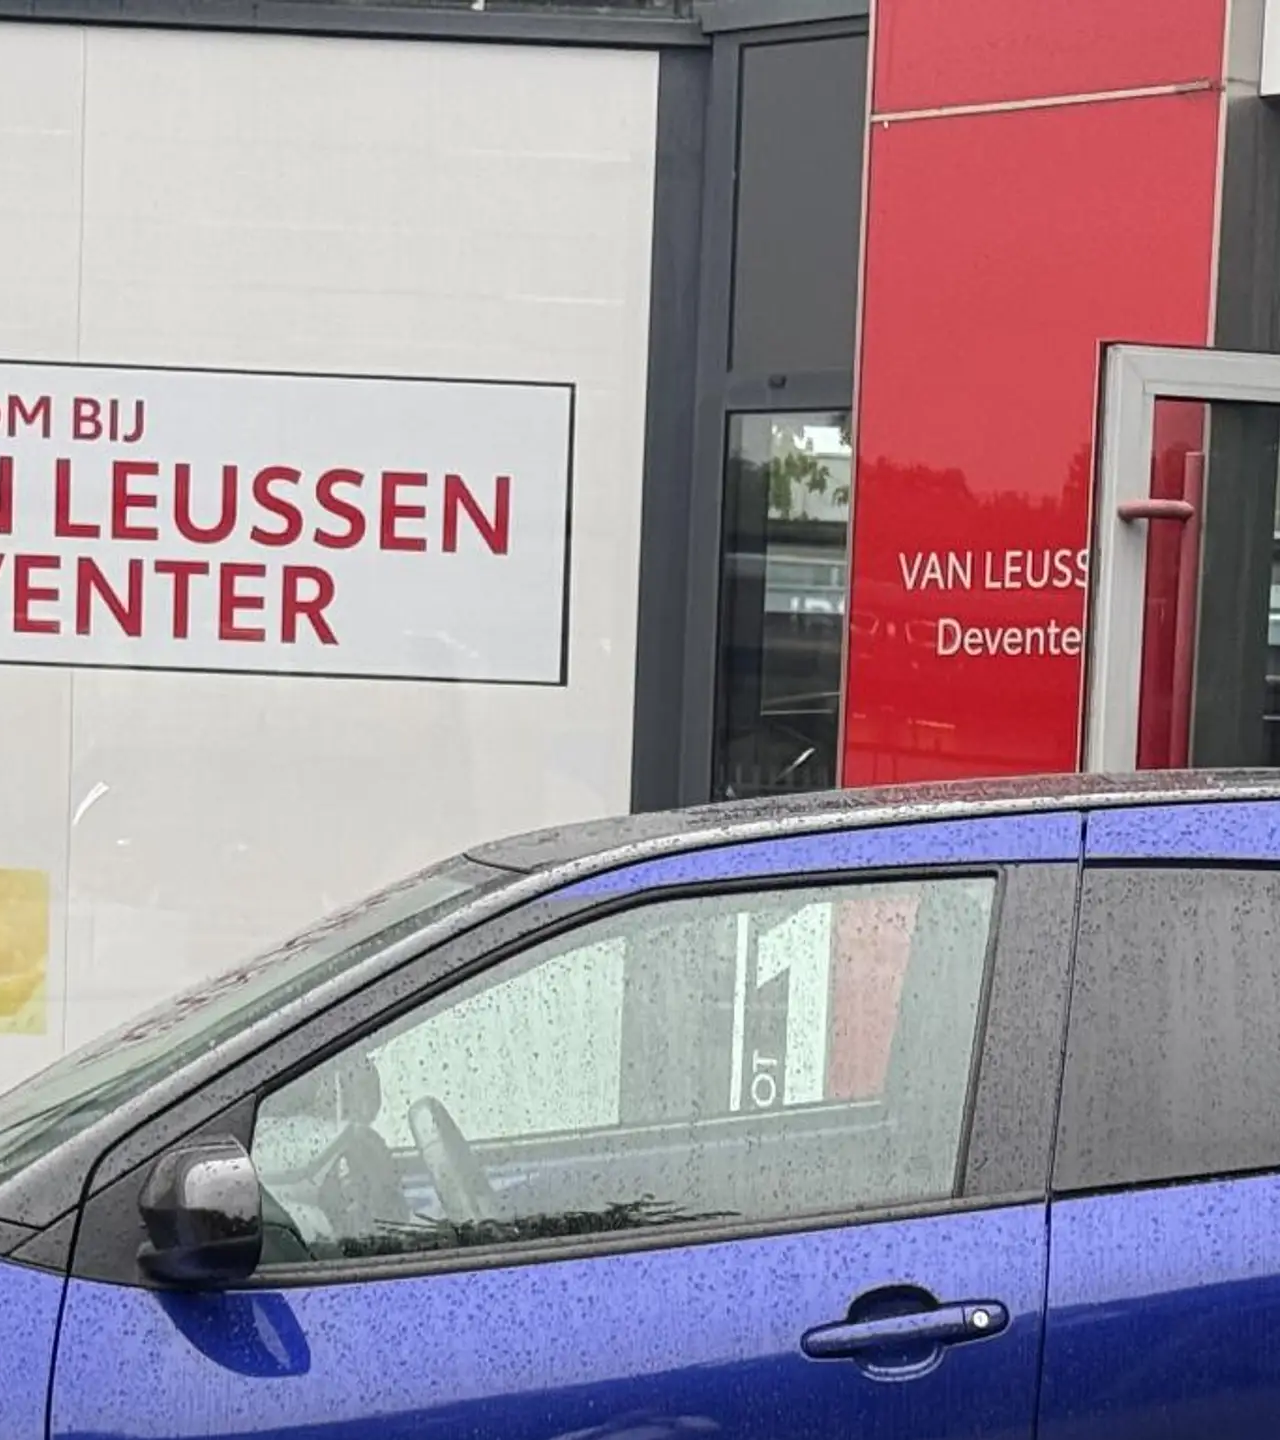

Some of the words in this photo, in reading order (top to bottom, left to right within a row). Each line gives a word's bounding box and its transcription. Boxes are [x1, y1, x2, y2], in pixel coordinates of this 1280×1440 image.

[72, 396, 146, 443] BIJ
[53, 458, 511, 555] LEUSSEN
[898, 551, 972, 591] VAN
[984, 548, 1089, 590] LEUSS
[936, 618, 1082, 656] Devente
